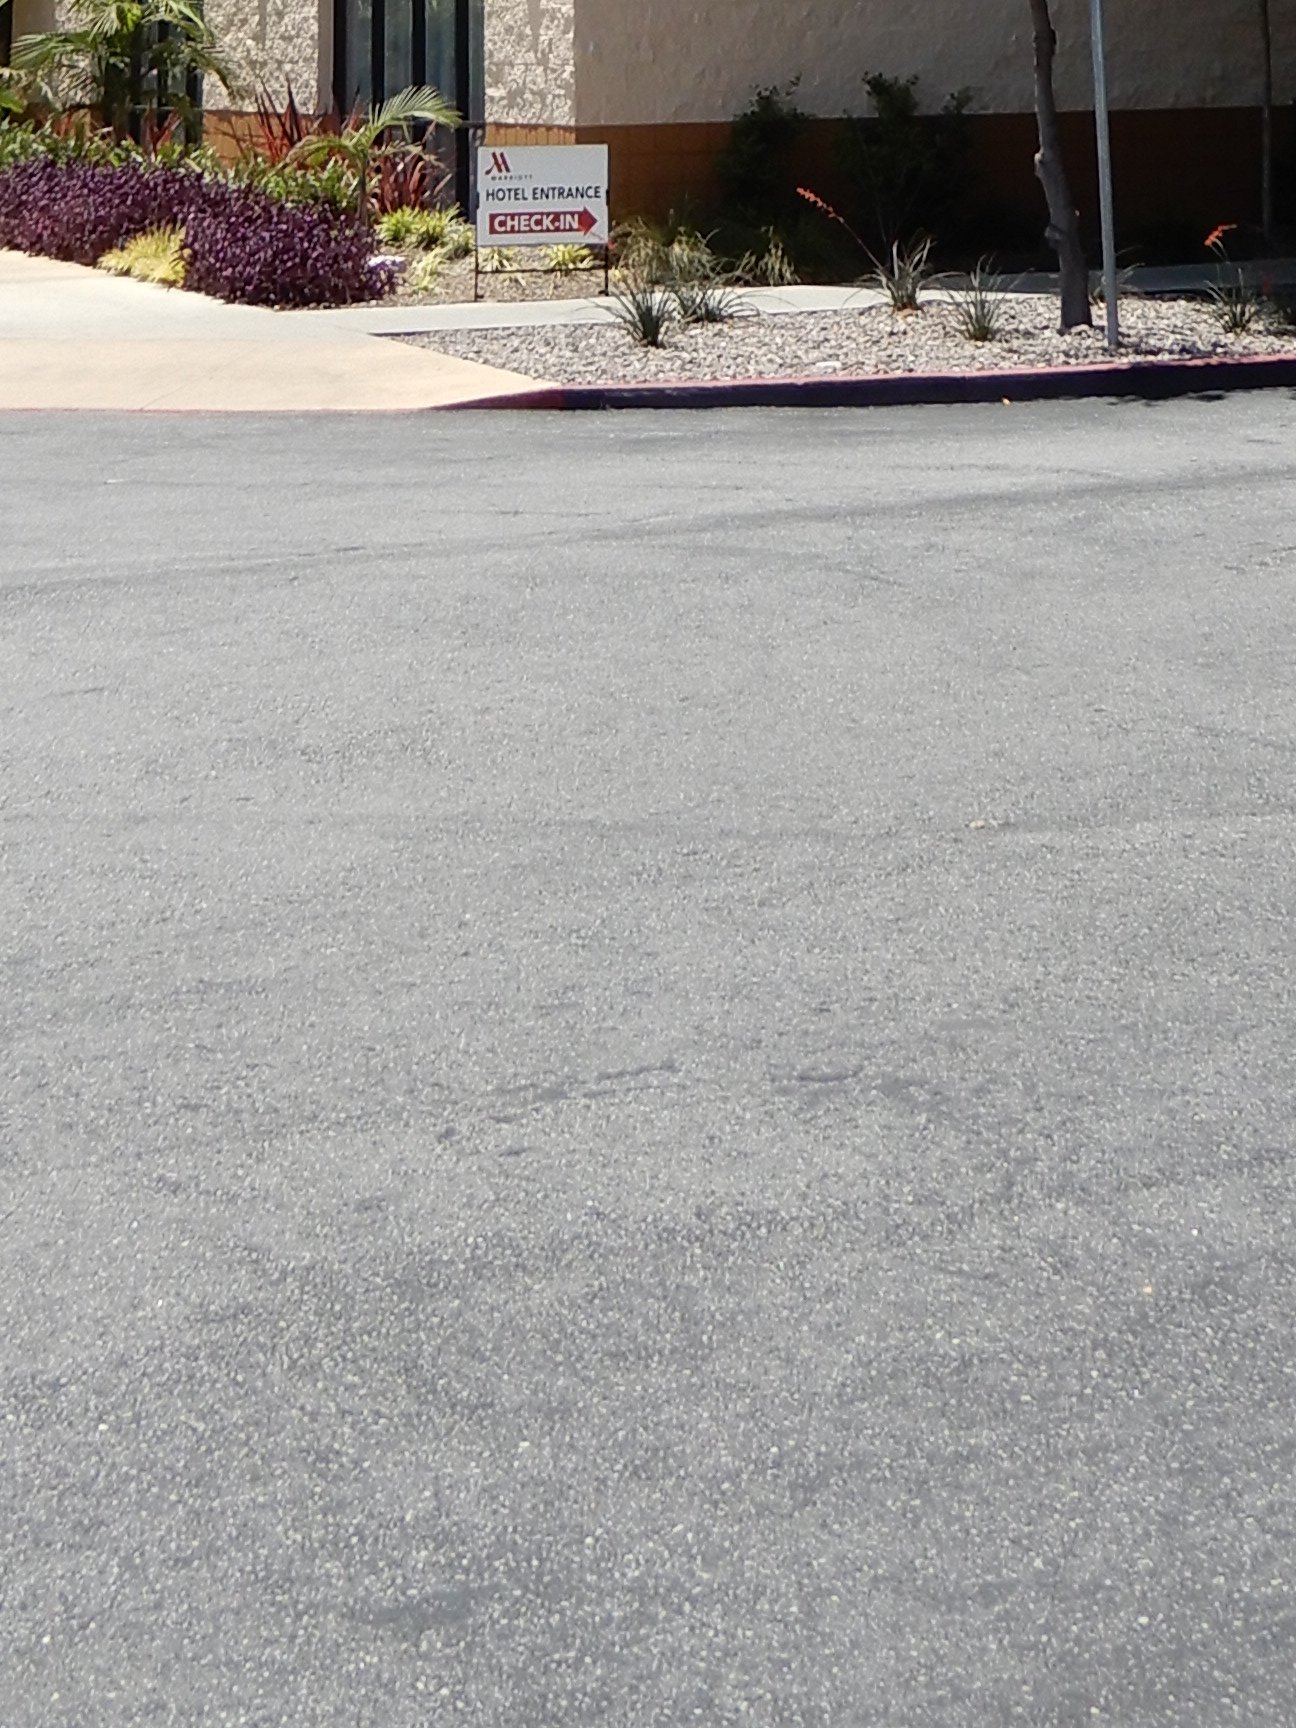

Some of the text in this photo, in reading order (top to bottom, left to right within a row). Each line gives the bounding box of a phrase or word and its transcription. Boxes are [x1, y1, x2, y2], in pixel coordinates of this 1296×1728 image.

[485, 185, 602, 202] HOTEL ENTRANCE
[493, 213, 580, 232] CHECK-IN
